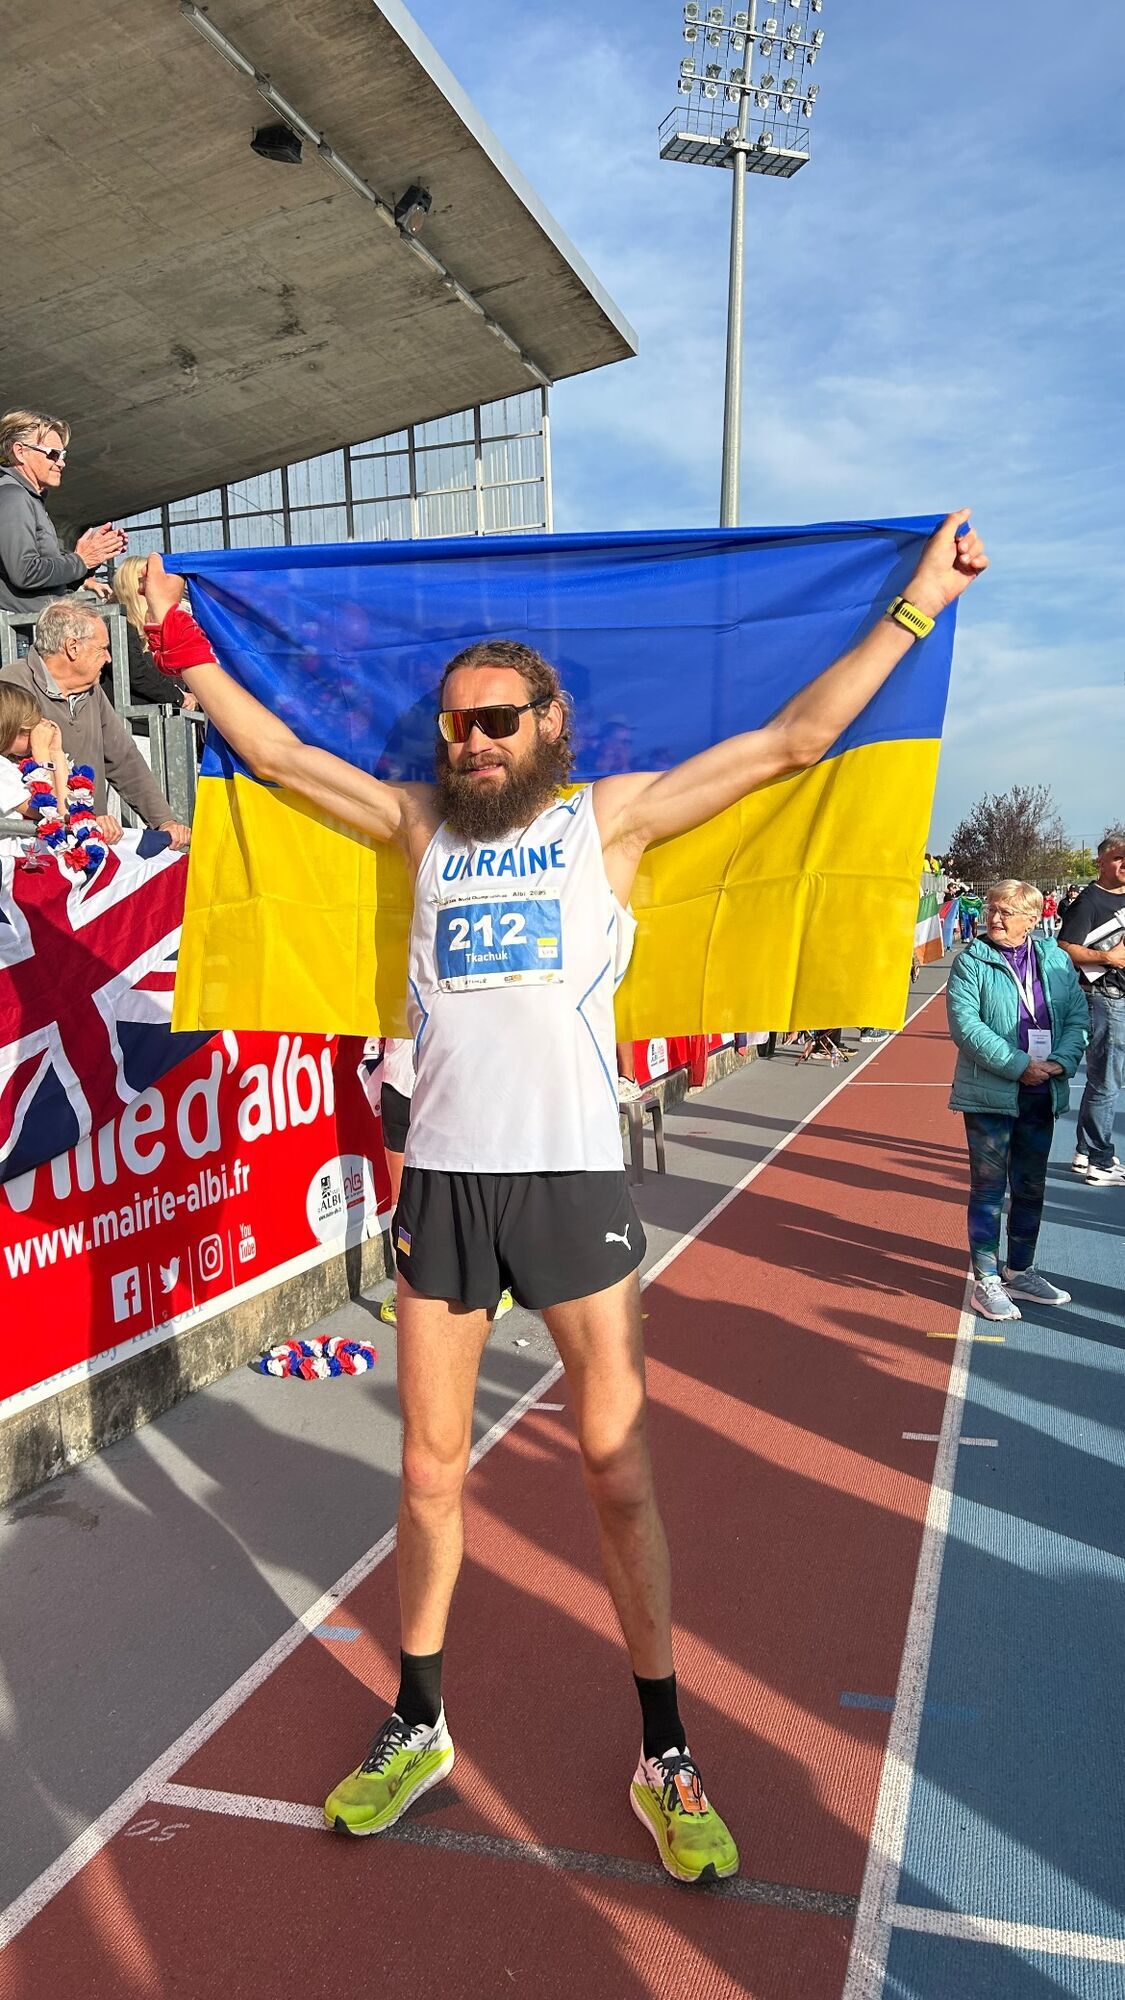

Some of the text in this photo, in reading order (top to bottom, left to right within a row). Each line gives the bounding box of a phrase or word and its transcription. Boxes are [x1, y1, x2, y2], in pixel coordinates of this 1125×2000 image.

[442, 840, 566, 881] UKRAINE
[449, 913, 527, 952] 212
[465, 950, 508, 964] Tkachuk
[320, 1193, 342, 1212] ALBI
[4, 1159, 250, 1279] www.mairie-albi.fr
[239, 1223, 252, 1239] You
[240, 1241, 255, 1259] Tube
